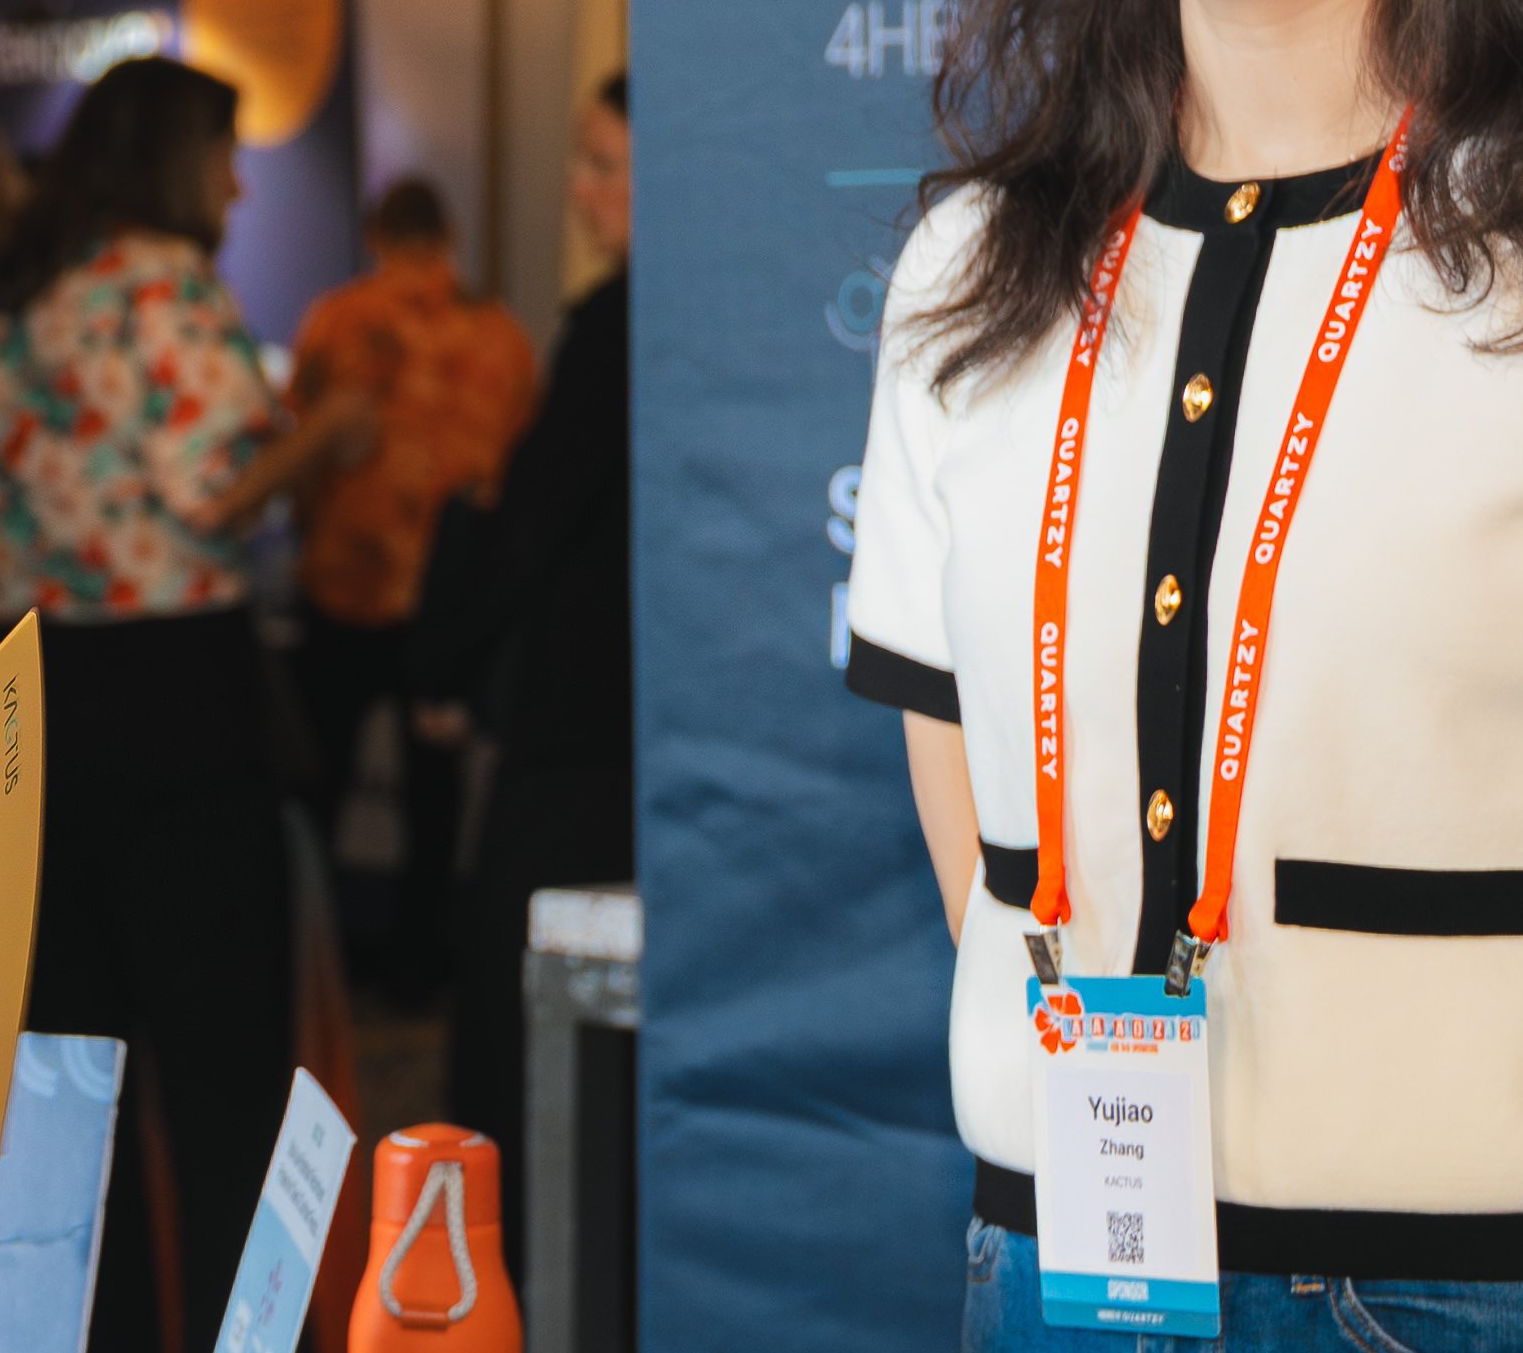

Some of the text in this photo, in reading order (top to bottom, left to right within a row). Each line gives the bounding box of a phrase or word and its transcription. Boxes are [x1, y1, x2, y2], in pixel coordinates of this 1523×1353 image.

[1317, 218, 1383, 364] QUARTZY
[1043, 416, 1080, 568] QUARTZY
[1254, 411, 1314, 565] QUARTZY
[2, 673, 21, 797] KACTUS
[1039, 621, 1059, 781] QUARTZY
[1219, 617, 1259, 782] QUARTZY
[1088, 1095, 1155, 1127] Yujiao
[1099, 1139, 1146, 1161] Zhang
